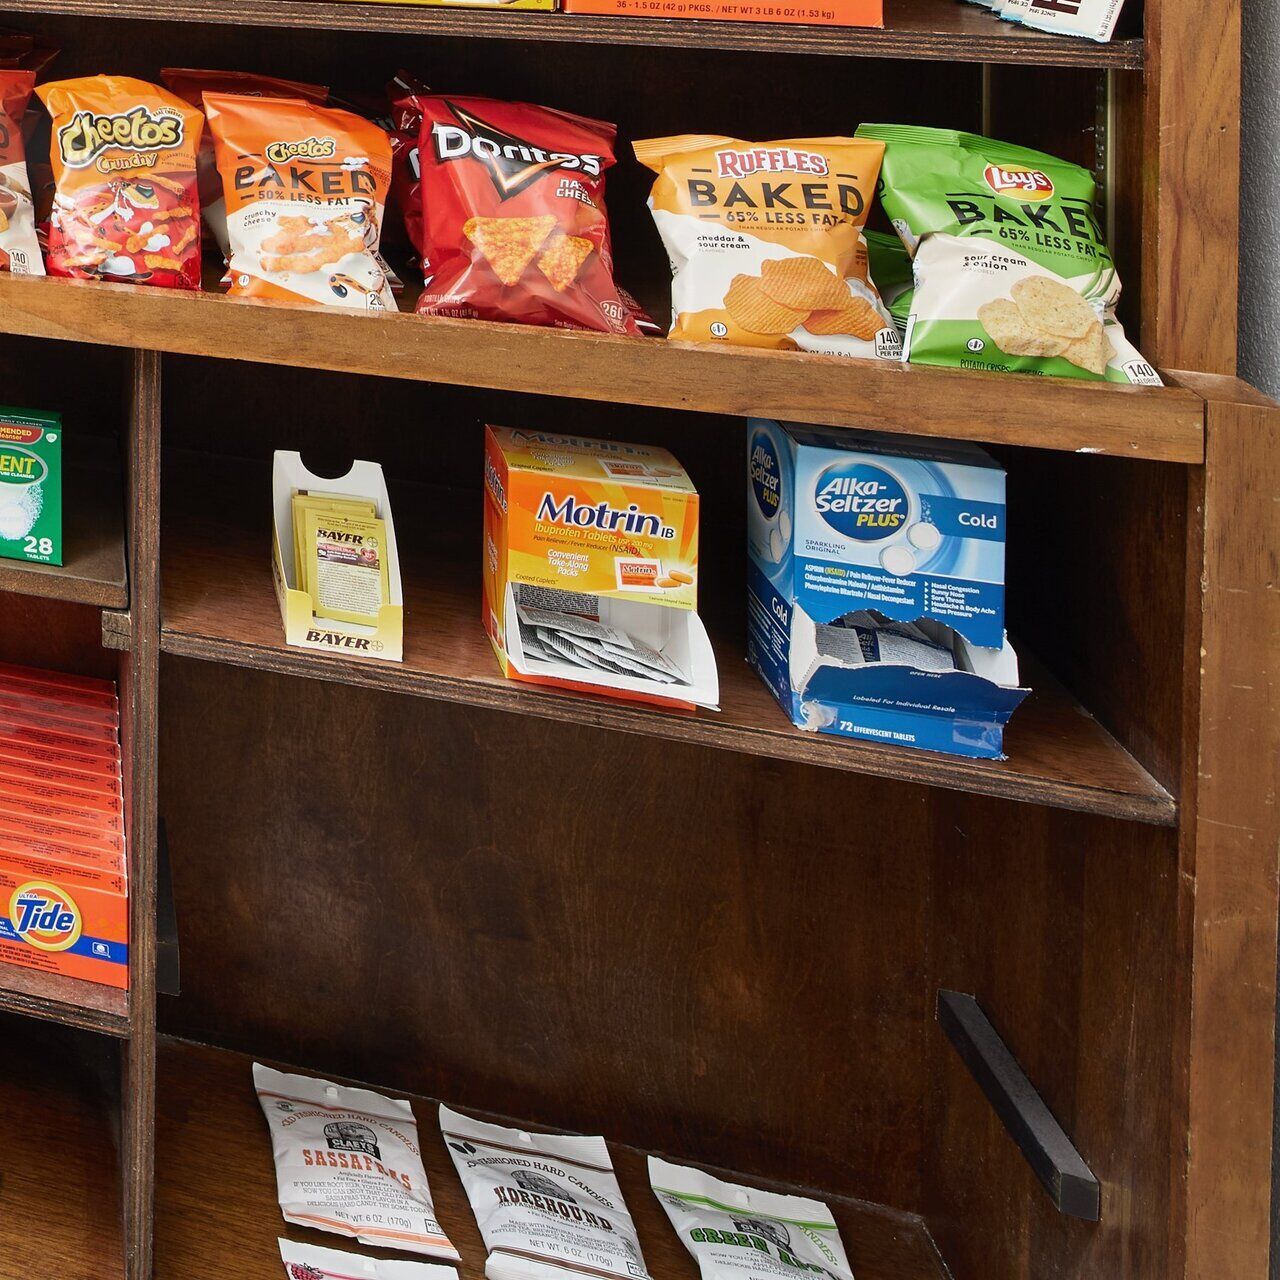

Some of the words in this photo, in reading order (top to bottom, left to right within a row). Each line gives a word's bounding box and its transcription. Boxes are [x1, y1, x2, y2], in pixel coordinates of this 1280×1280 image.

[60, 108, 183, 164] Cheetos
[267, 138, 335, 163] Cheetos
[433, 124, 601, 175] Doritos
[97, 152, 158, 173] Crunchy
[717, 148, 829, 178] RUFFLES
[235, 163, 377, 195] BAKED
[992, 167, 1052, 191] Lay's
[688, 179, 864, 216] BAKED
[726, 211, 759, 221] 65%
[766, 213, 805, 224] LESS
[813, 214, 838, 226] FAT
[999, 227, 1030, 241] 65%
[1036, 235, 1071, 251] LESS
[1078, 244, 1097, 258] FAT
[820, 477, 886, 496] Alka-
[537, 493, 661, 536] Motrin
[815, 495, 901, 513] Seltzer
[857, 514, 899, 527] PLUS
[958, 513, 997, 529] Cold
[535, 524, 580, 538] Ibuprofen
[583, 530, 617, 542] Tablets
[24, 536, 53, 555] 28
[806, 539, 846, 550] SPARKLING
[806, 544, 840, 554] ORIGINAL
[547, 549, 589, 562] Convenient
[306, 631, 371, 650] BAYER
[840, 721, 853, 731] 72
[16, 899, 74, 932] Tide
[494, 1186, 613, 1230] HOREHOUND
[690, 1228, 771, 1254] GREEN
